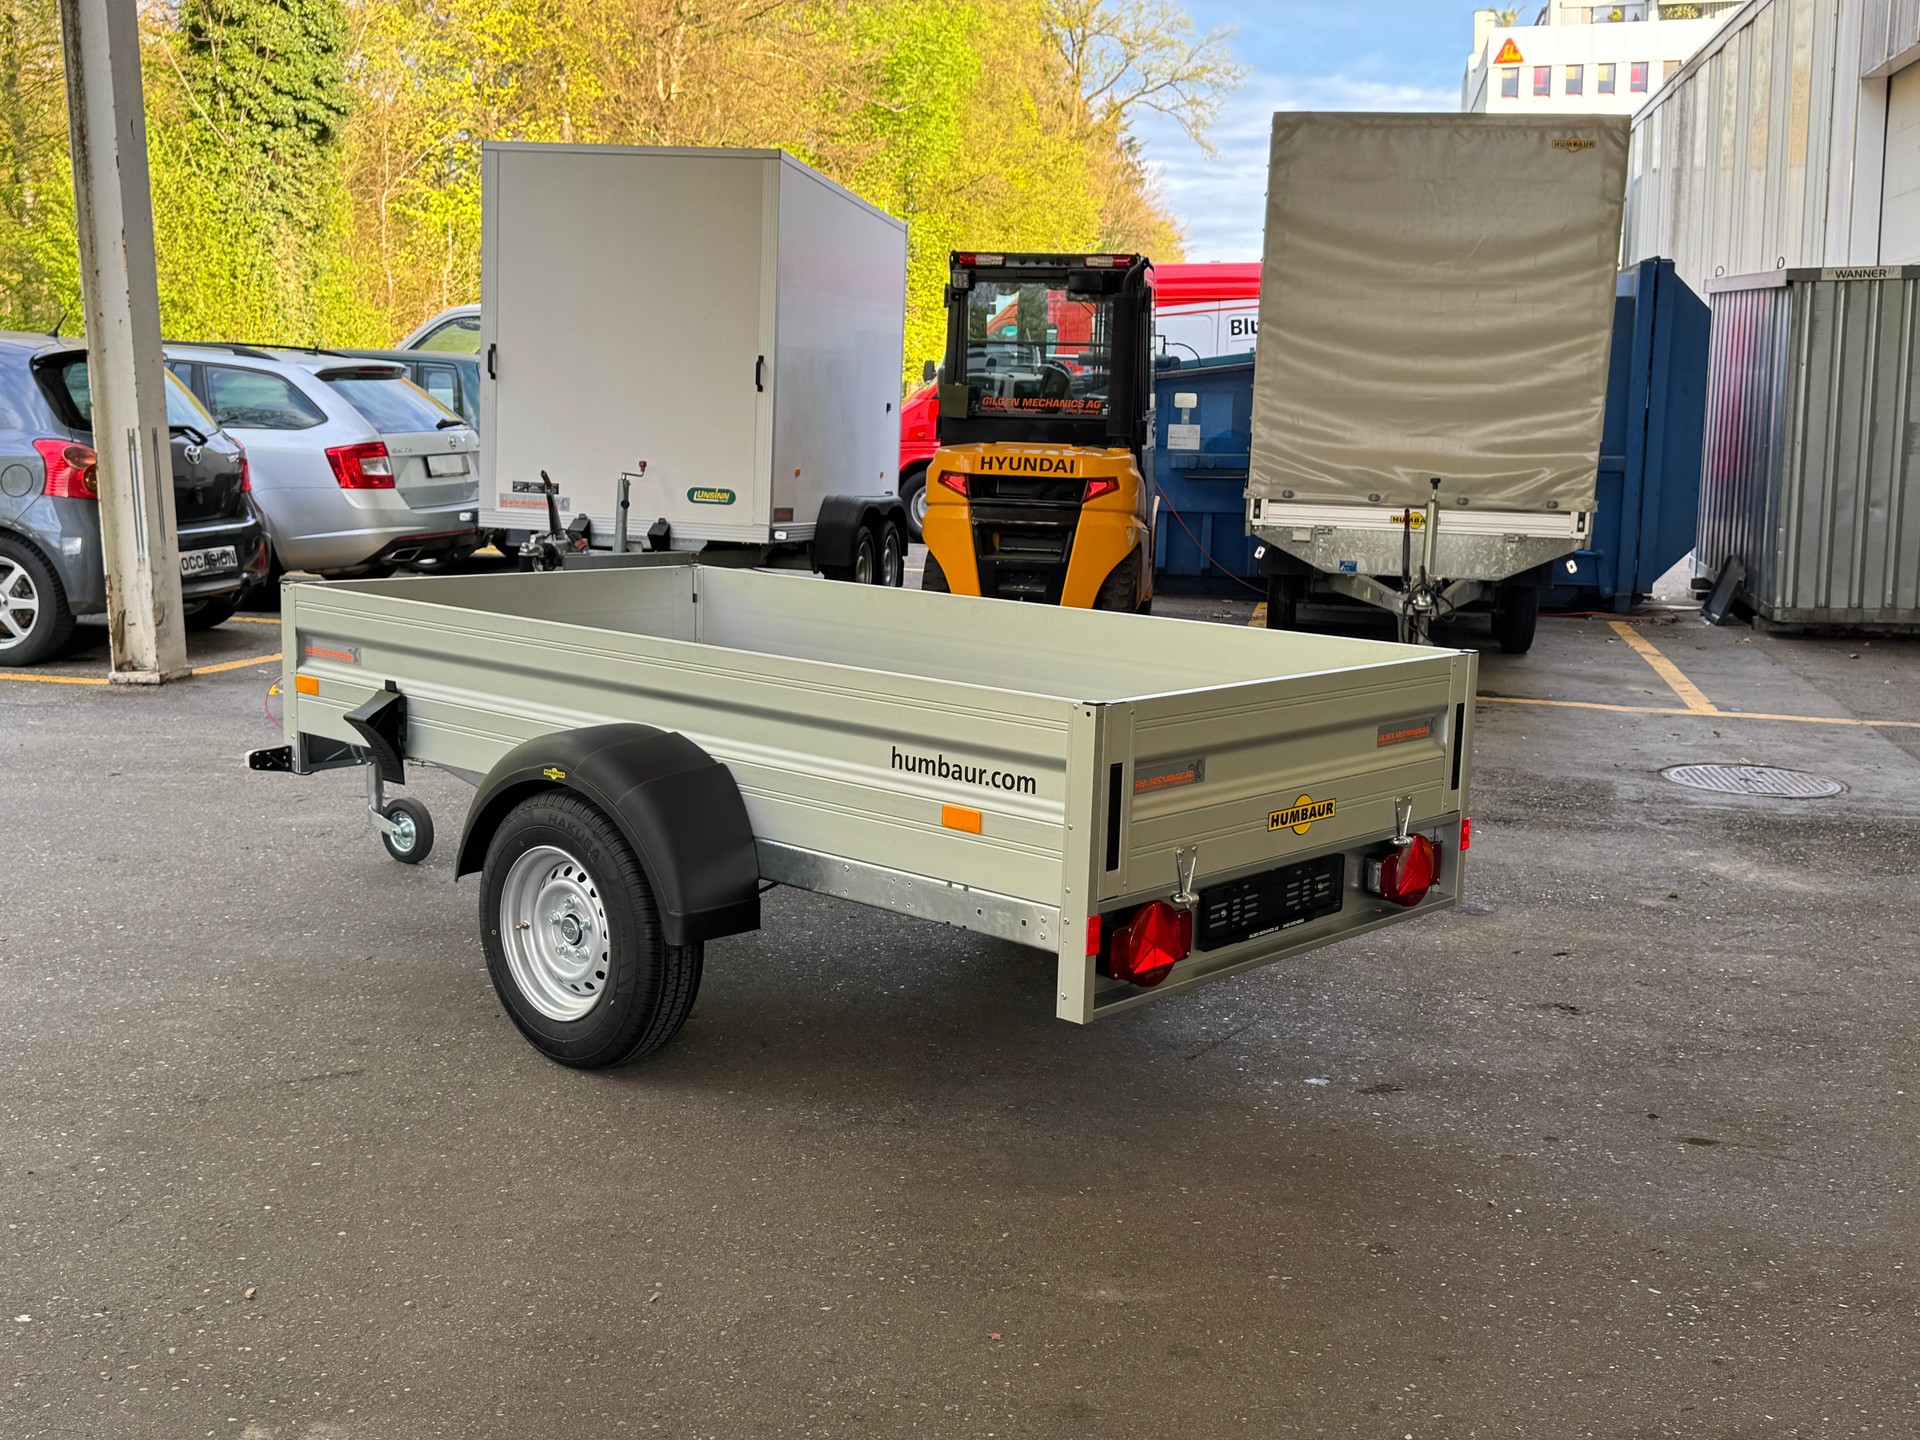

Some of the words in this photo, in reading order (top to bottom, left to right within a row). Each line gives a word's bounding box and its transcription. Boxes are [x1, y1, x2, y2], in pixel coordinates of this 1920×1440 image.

[1835, 268, 1887, 279] WANNER
[981, 396, 1020, 407] GILGEN
[1022, 397, 1085, 409] MECHANICS
[1086, 399, 1102, 409] AG
[980, 456, 1075, 474] HYUNDAI
[181, 550, 237, 571] OCCASION
[891, 745, 1037, 795] humbaur.com
[1271, 802, 1334, 828] HUMBAUR
[548, 813, 600, 863] HAKUBA
